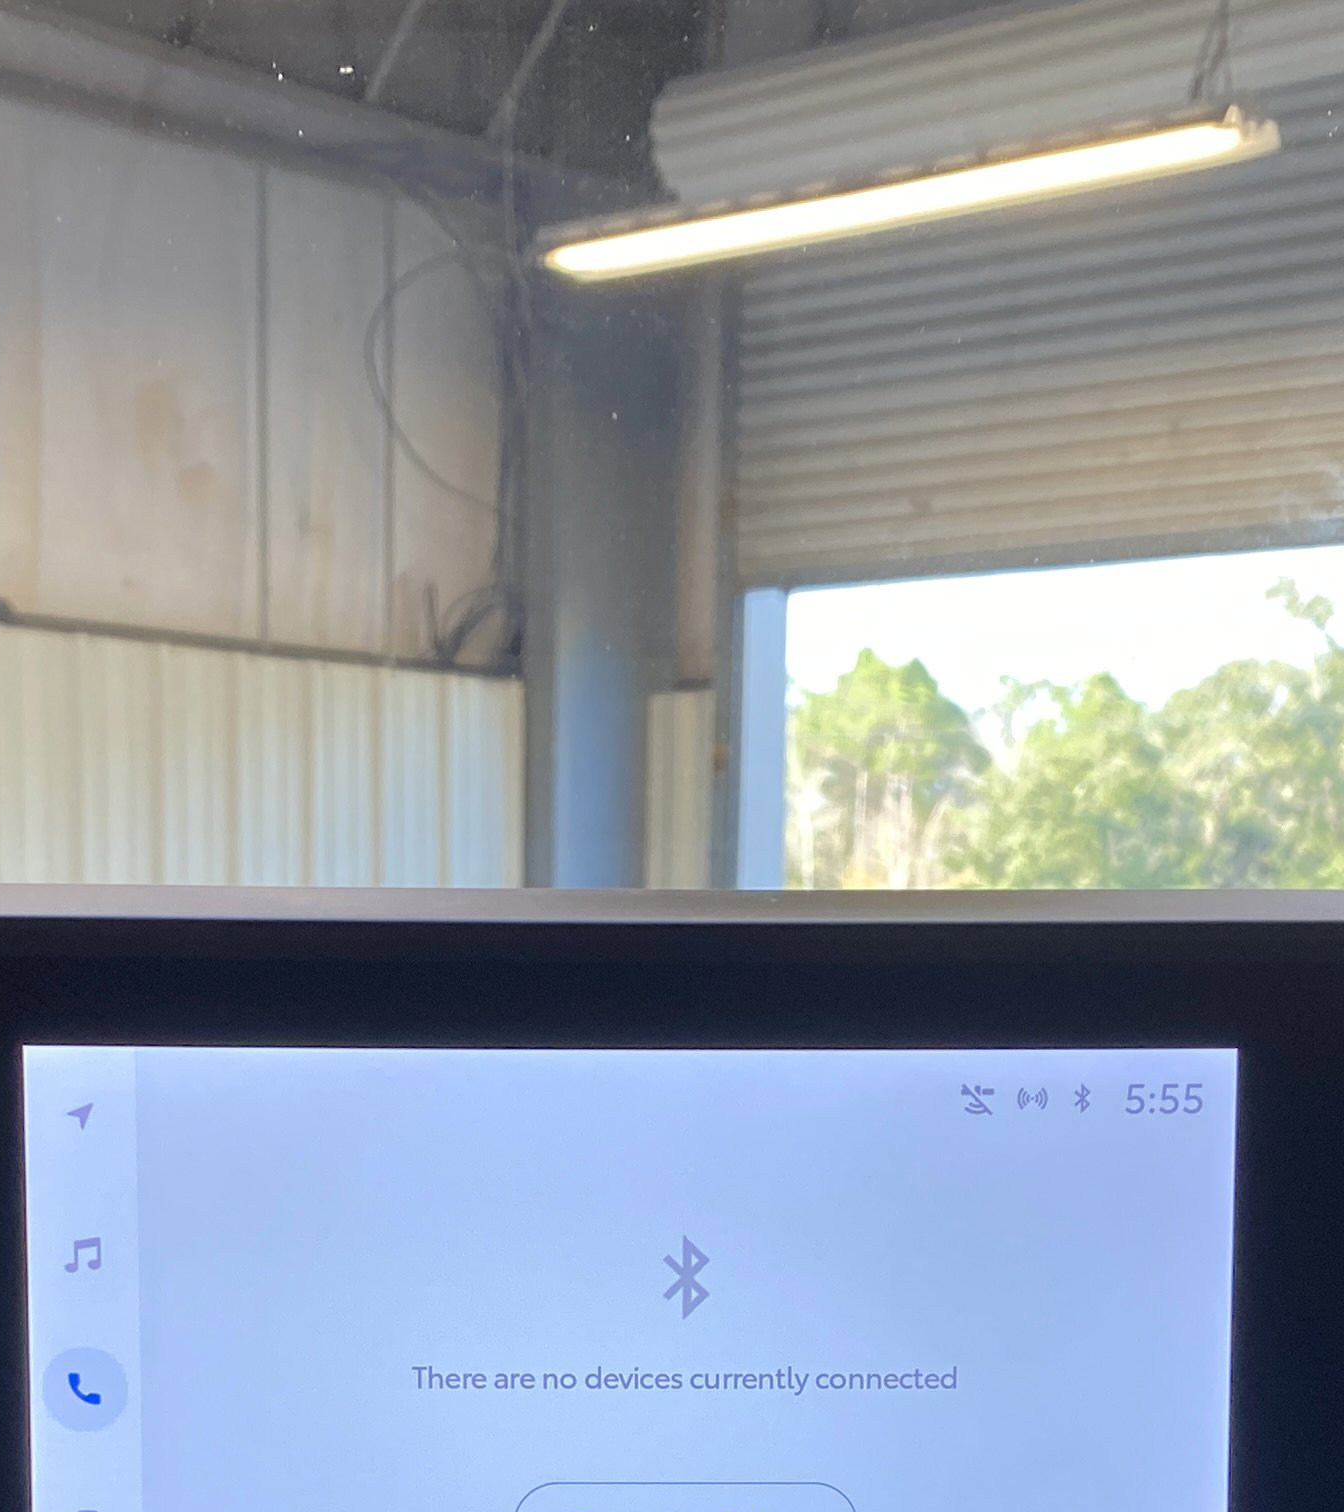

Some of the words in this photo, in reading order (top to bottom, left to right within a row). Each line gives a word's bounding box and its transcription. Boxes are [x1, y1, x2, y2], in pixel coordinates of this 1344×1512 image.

[1124, 1083, 1203, 1115] 5:55
[411, 1365, 487, 1390] There
[494, 1372, 536, 1390] are
[542, 1372, 578, 1390] no
[584, 1365, 683, 1390] devices
[689, 1365, 810, 1397] currently
[815, 1365, 958, 1390] connected
